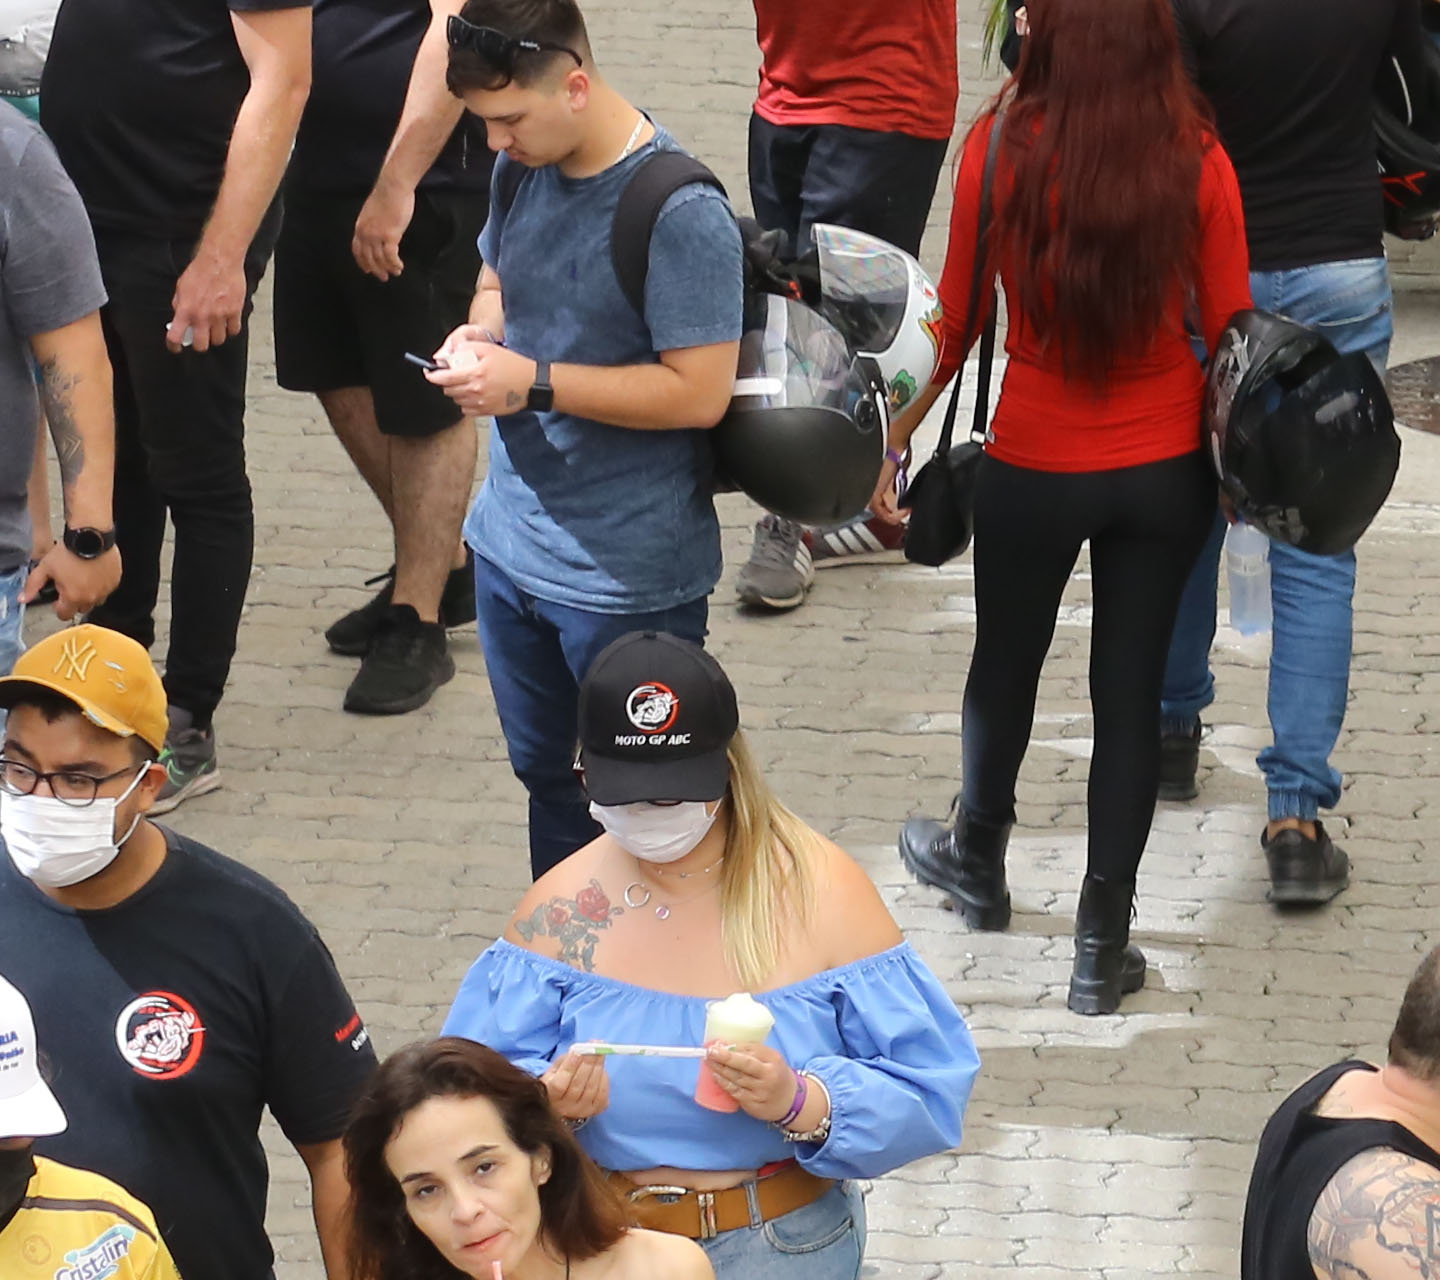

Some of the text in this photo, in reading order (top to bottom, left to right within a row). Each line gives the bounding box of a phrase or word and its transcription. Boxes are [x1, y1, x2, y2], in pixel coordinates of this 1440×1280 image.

[53, 634, 97, 682] NY
[615, 733, 691, 746] MOTO GP ABC
